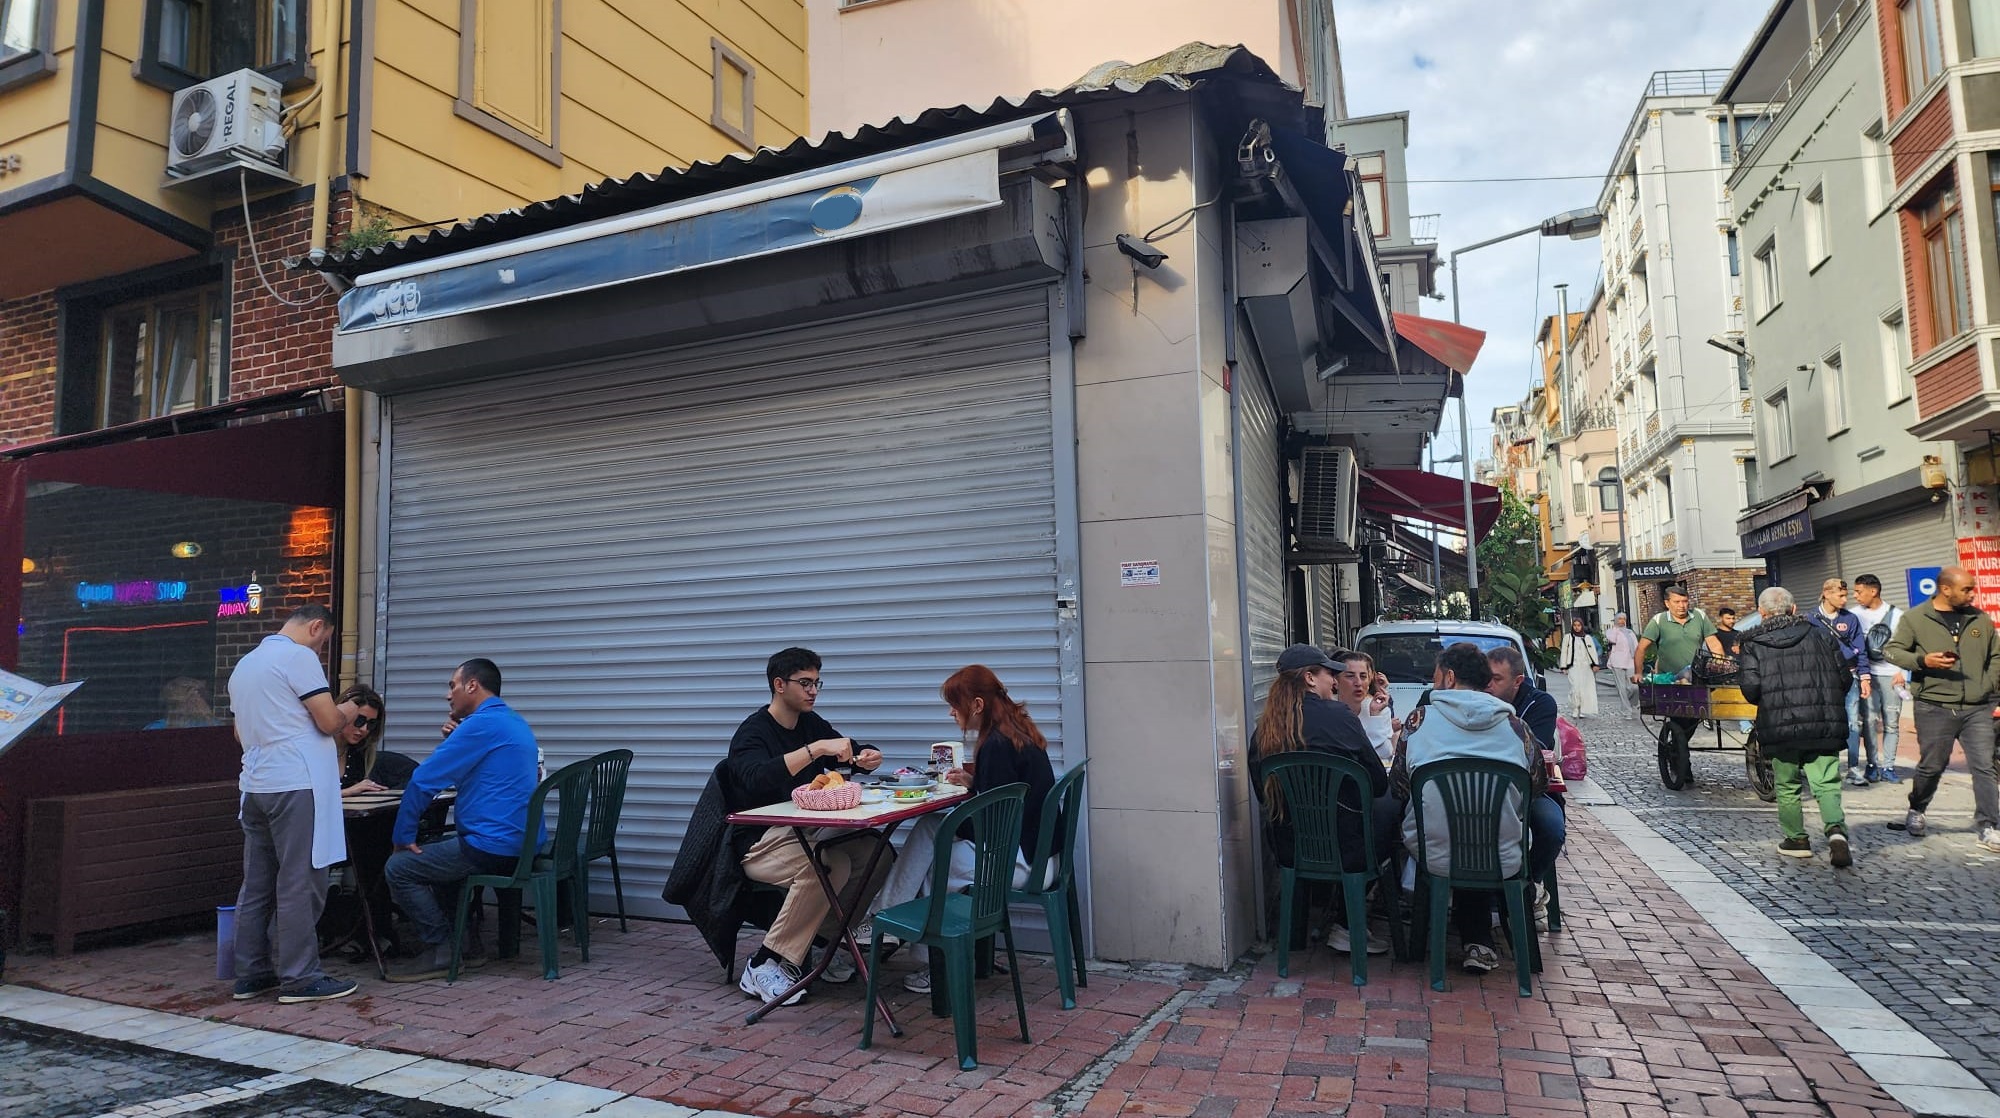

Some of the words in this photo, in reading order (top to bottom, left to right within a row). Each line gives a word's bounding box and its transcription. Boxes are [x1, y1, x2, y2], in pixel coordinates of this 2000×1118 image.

[223, 79, 237, 137] REGAL
[1787, 518, 1804, 540] EŞYA
[1976, 540, 2000, 552] YUNU
[1631, 565, 1671, 576] ALESSIA
[1977, 557, 2000, 570] KUR
[217, 601, 249, 616] AWAY
